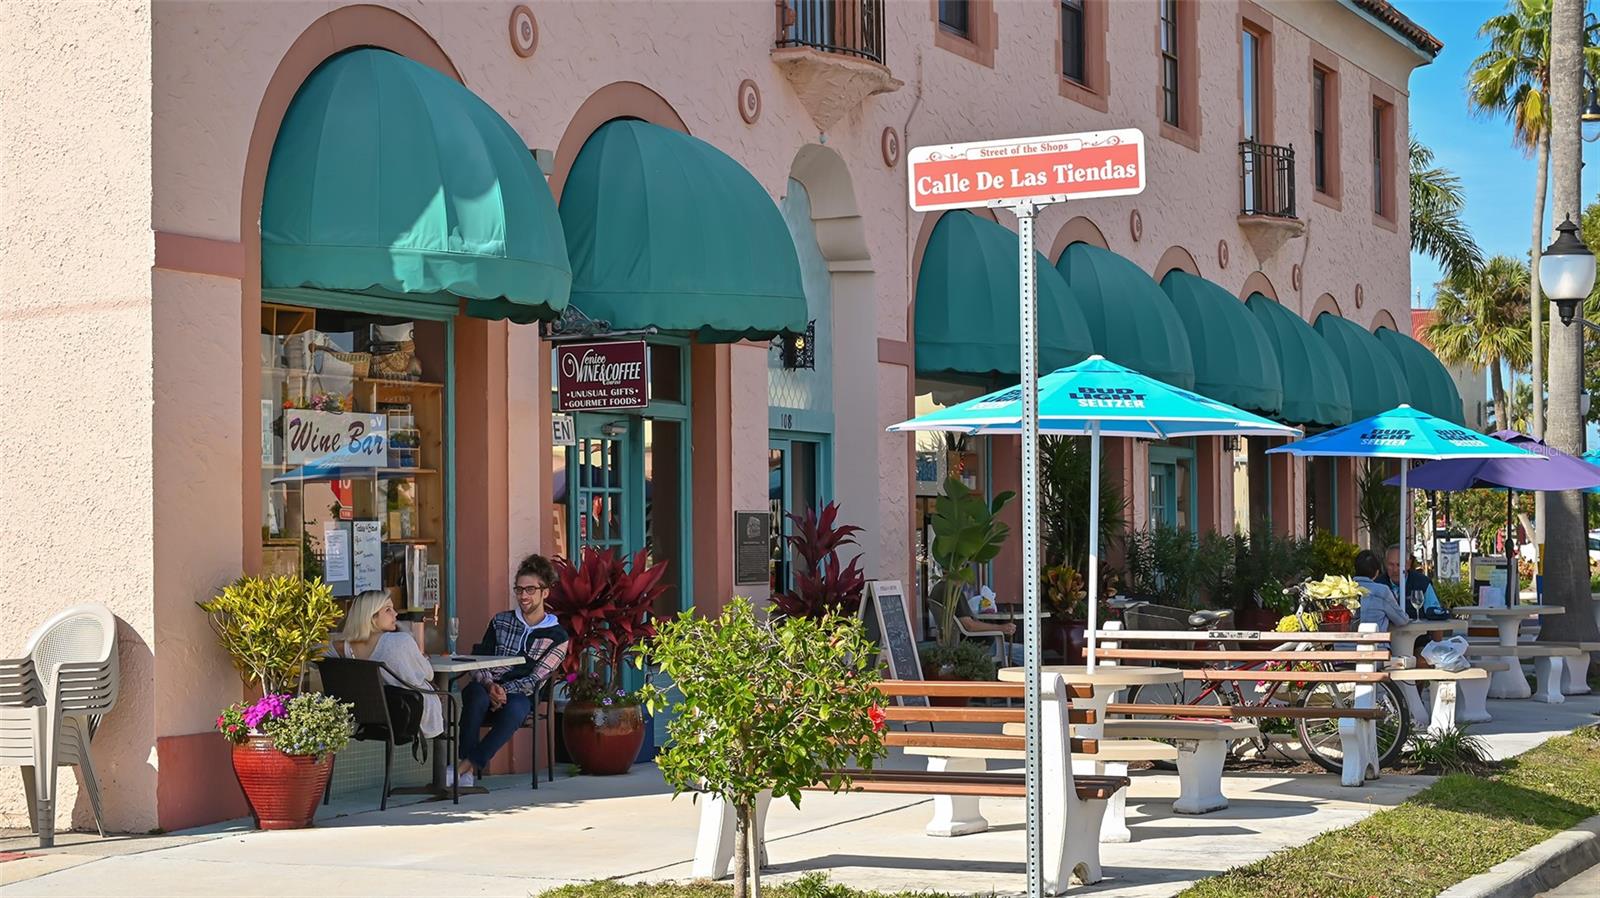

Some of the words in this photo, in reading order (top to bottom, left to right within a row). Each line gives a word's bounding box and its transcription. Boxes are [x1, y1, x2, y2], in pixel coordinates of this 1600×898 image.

[980, 147, 1008, 158] Street
[1010, 145, 1021, 155] of
[1023, 144, 1038, 154] the
[1040, 142, 1069, 153] Shops
[917, 172, 970, 196] Calle
[976, 170, 1005, 190] De
[1010, 168, 1048, 188] Las
[1052, 159, 1137, 184] Tiendas
[570, 389, 609, 398] UNUSUAL
[610, 387, 634, 396] GIFTS
[569, 398, 607, 408] GOURMET
[609, 397, 637, 406] FOODS
[1078, 399, 1146, 408] SELTZER
[780, 413, 793, 429] 108
[289, 417, 341, 453] Wine
[348, 420, 384, 455] Bar
